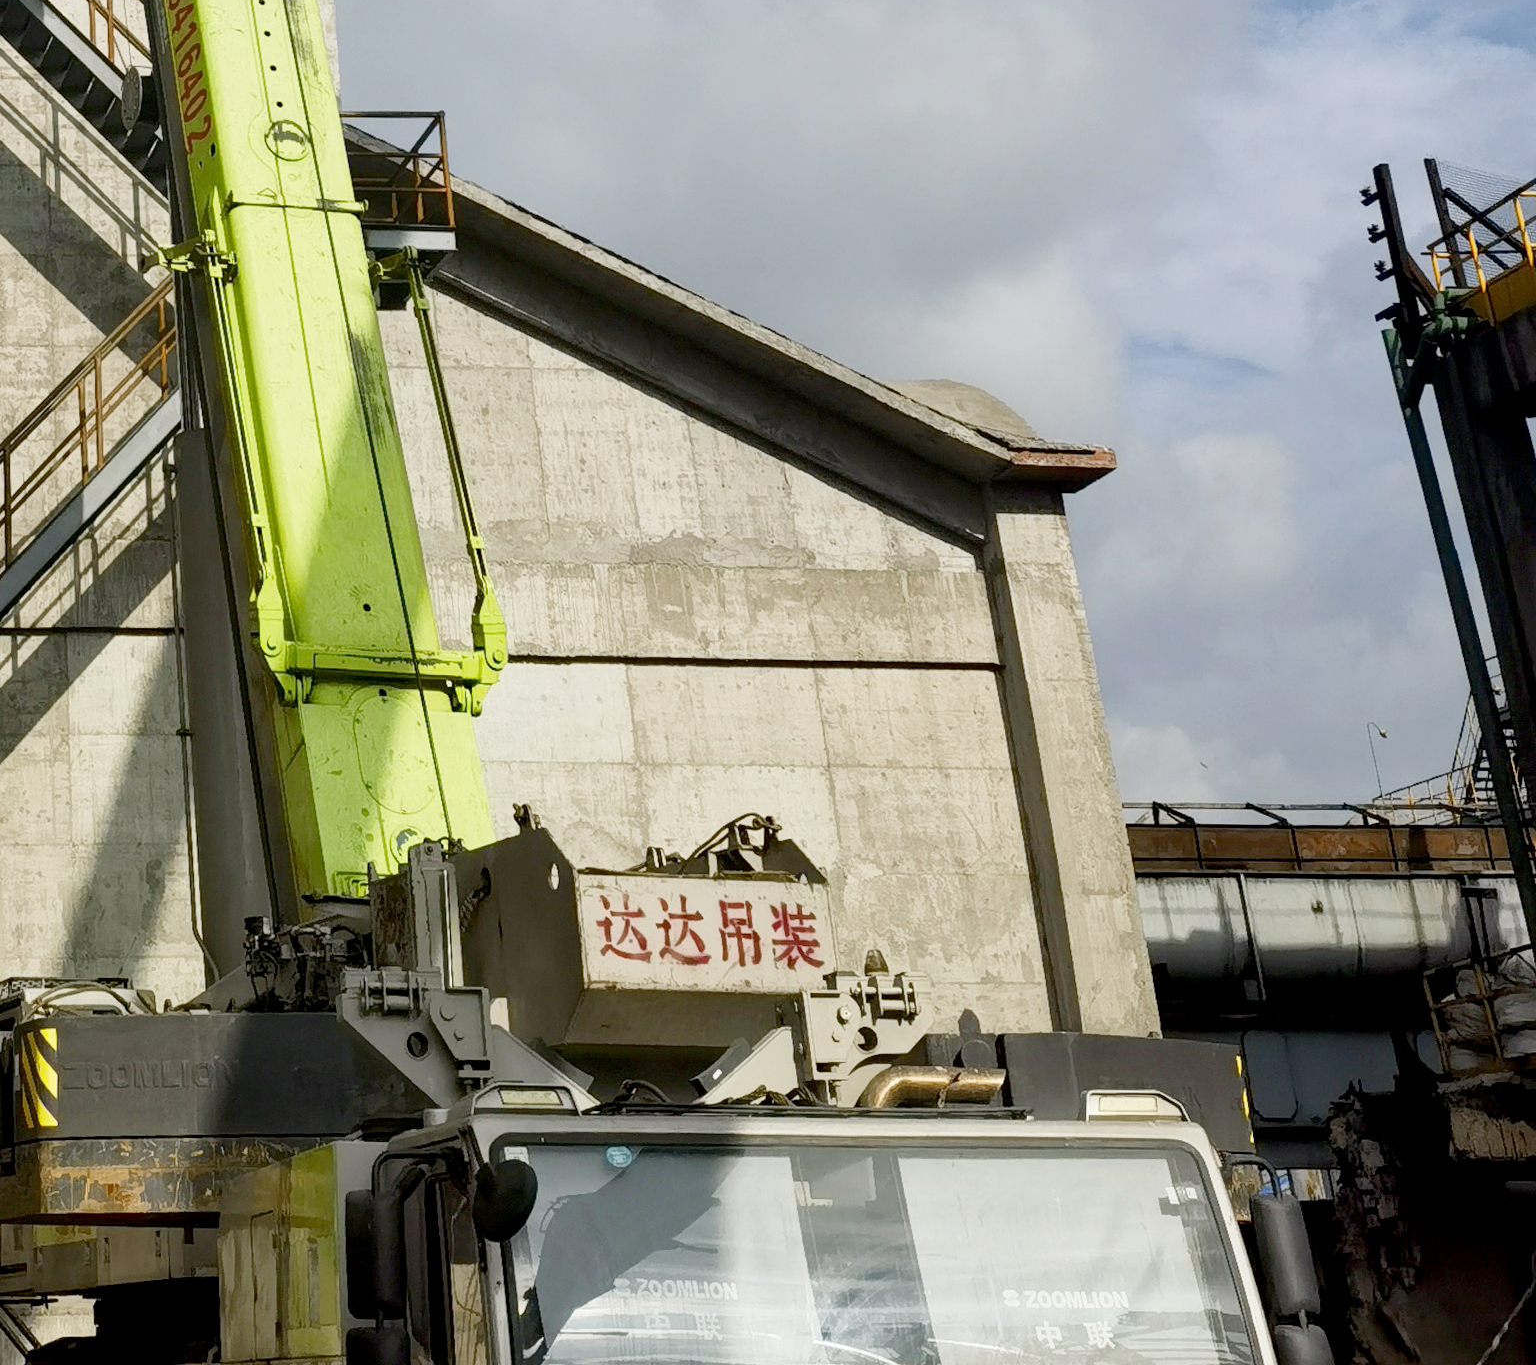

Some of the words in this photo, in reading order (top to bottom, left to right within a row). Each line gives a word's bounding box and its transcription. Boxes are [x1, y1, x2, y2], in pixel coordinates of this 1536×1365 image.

[596, 894, 825, 971] 达达吊装
[63, 1059, 240, 1090] ZOOMLION
[636, 1277, 738, 1301] ZOOMLION
[1024, 1289, 1130, 1310] ZOOMLION
[1035, 1320, 1116, 1350] 中联
